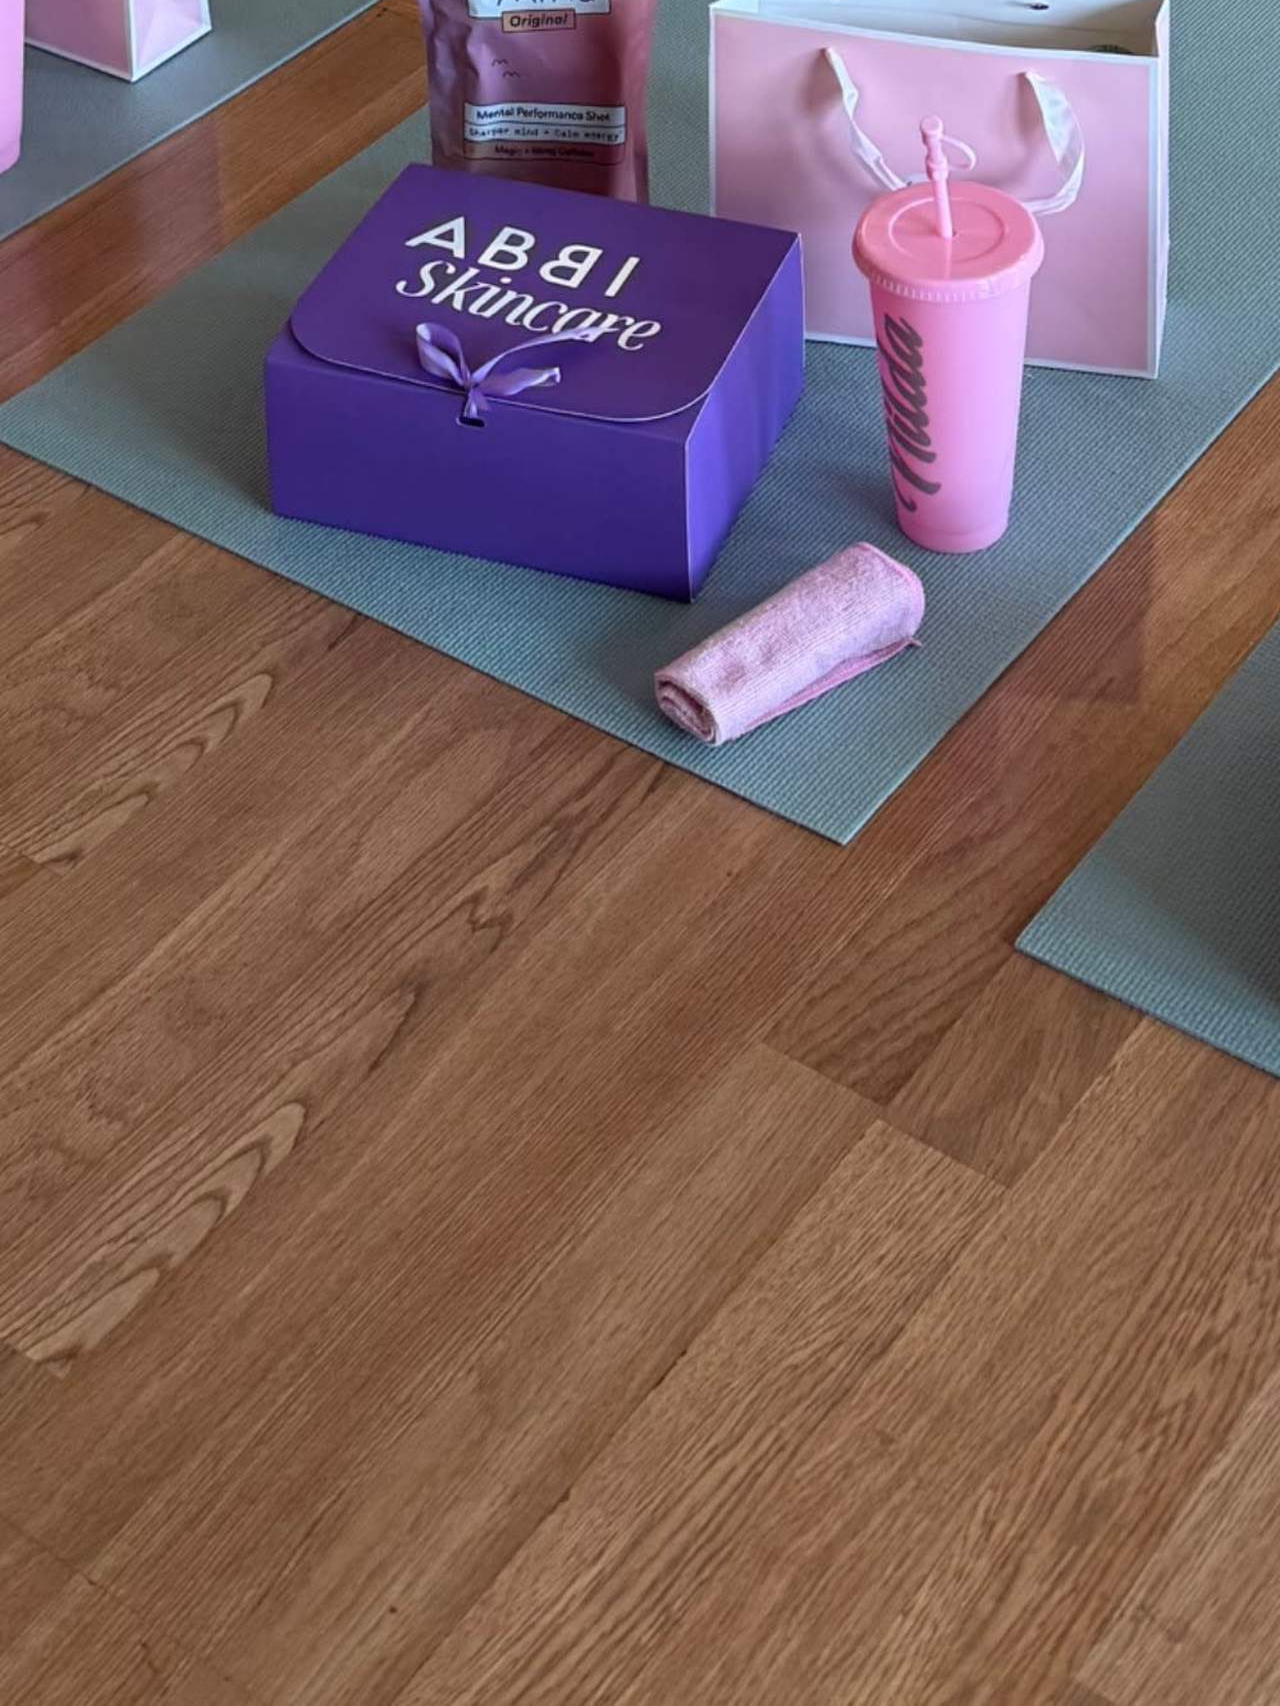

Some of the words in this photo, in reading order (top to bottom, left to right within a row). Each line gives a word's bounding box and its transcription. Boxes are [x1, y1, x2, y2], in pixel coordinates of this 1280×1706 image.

[509, 13, 569, 29] Original
[476, 107, 515, 121] Mental
[516, 107, 584, 121] Performance
[585, 109, 610, 122] Shot
[405, 216, 640, 297] ABBI
[395, 260, 662, 351] Skincare
